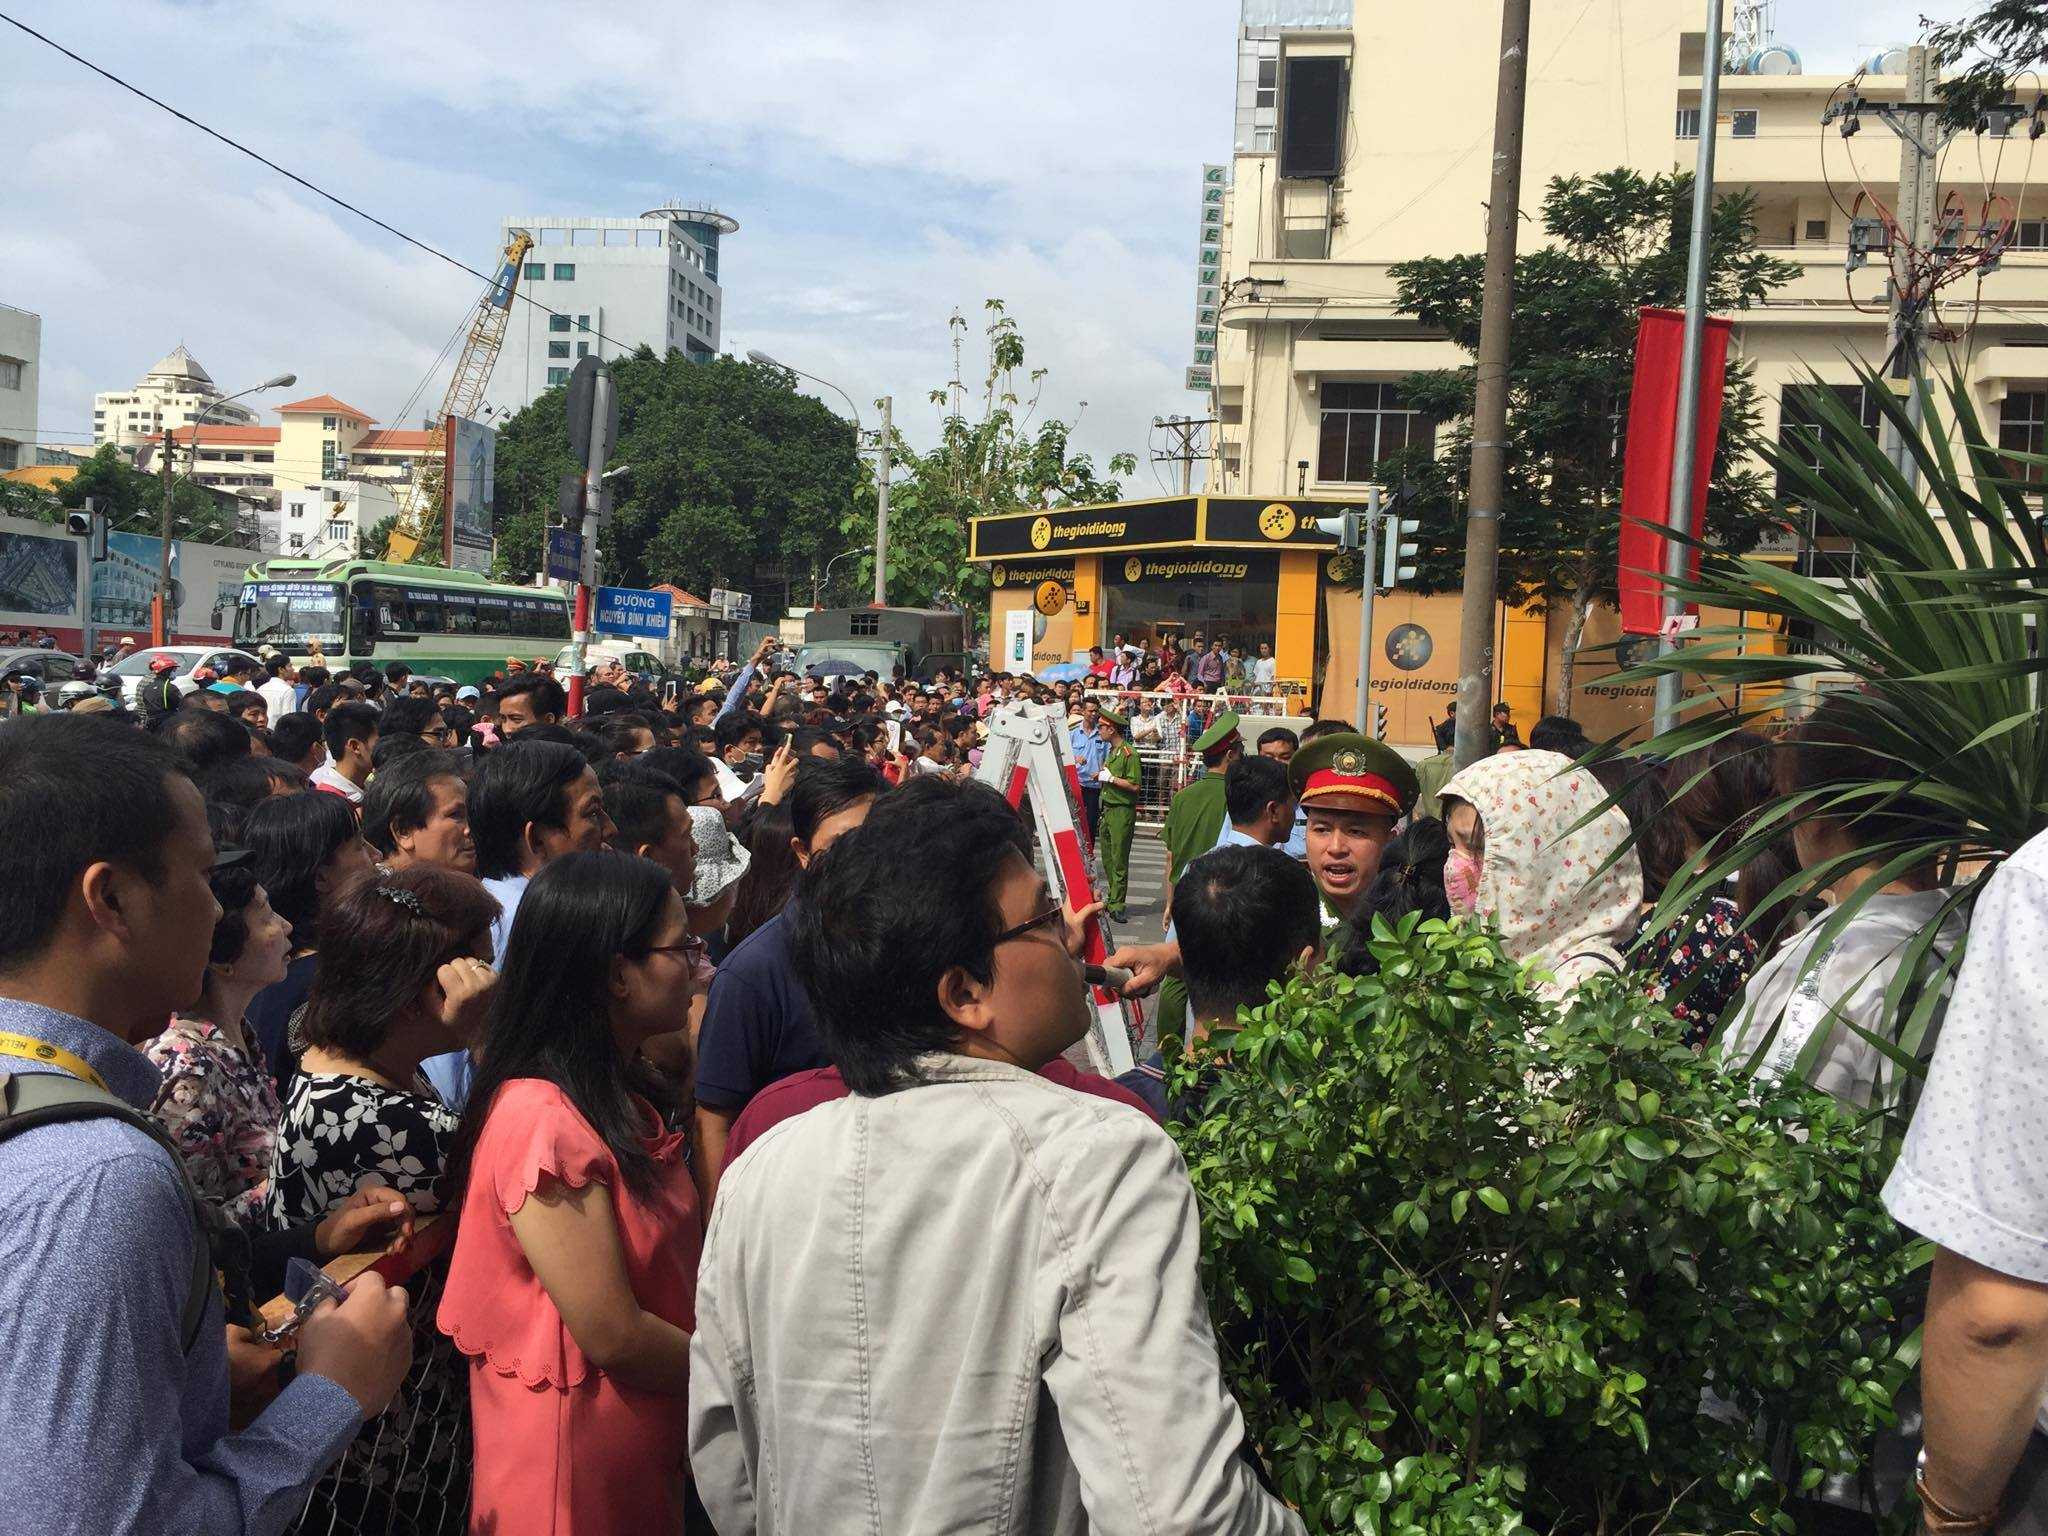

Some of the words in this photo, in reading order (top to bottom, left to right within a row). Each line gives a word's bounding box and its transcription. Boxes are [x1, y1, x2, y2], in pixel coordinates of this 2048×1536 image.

[1053, 522, 1126, 540] thegioididong
[1008, 568, 1075, 583] thegioididon
[1145, 561, 1248, 578] thegioididong
[614, 594, 656, 608] ĐƯỜNG
[600, 607, 626, 625] NGUYỄN
